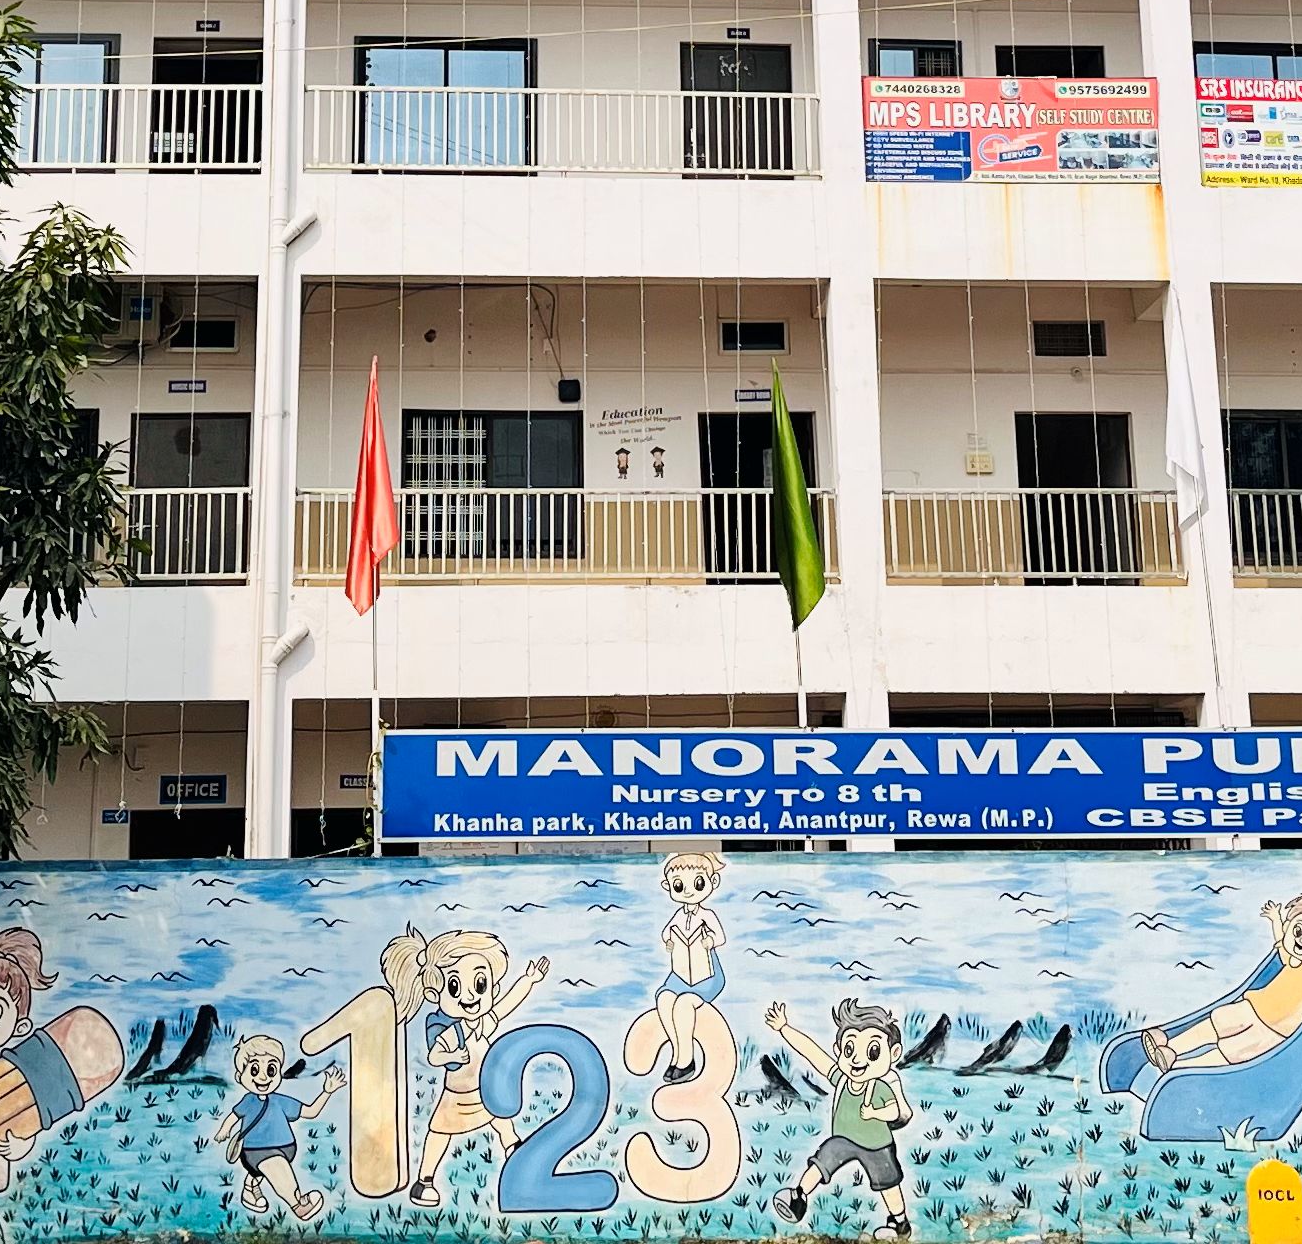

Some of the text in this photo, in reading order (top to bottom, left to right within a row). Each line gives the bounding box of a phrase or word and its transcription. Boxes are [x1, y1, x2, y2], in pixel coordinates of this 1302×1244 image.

[885, 84, 961, 94] 7440268328
[1068, 85, 1147, 95] 9575692499
[1199, 80, 1228, 98] SRS
[869, 101, 1037, 129] MPS LIBRARY
[1036, 108, 1155, 126] (SELF STUDY CENTRE)
[601, 406, 663, 420] Education
[436, 738, 1103, 777] MANORAMA
[166, 782, 219, 797] OFFICE
[612, 783, 922, 807] Nursery To 8 th
[434, 807, 1053, 835] Khanha park, Khadan Road, Anantpur, Rewa (M.P.)
[1086, 808, 1245, 827] CBSE
[1258, 1189, 1295, 1202] IOCL
